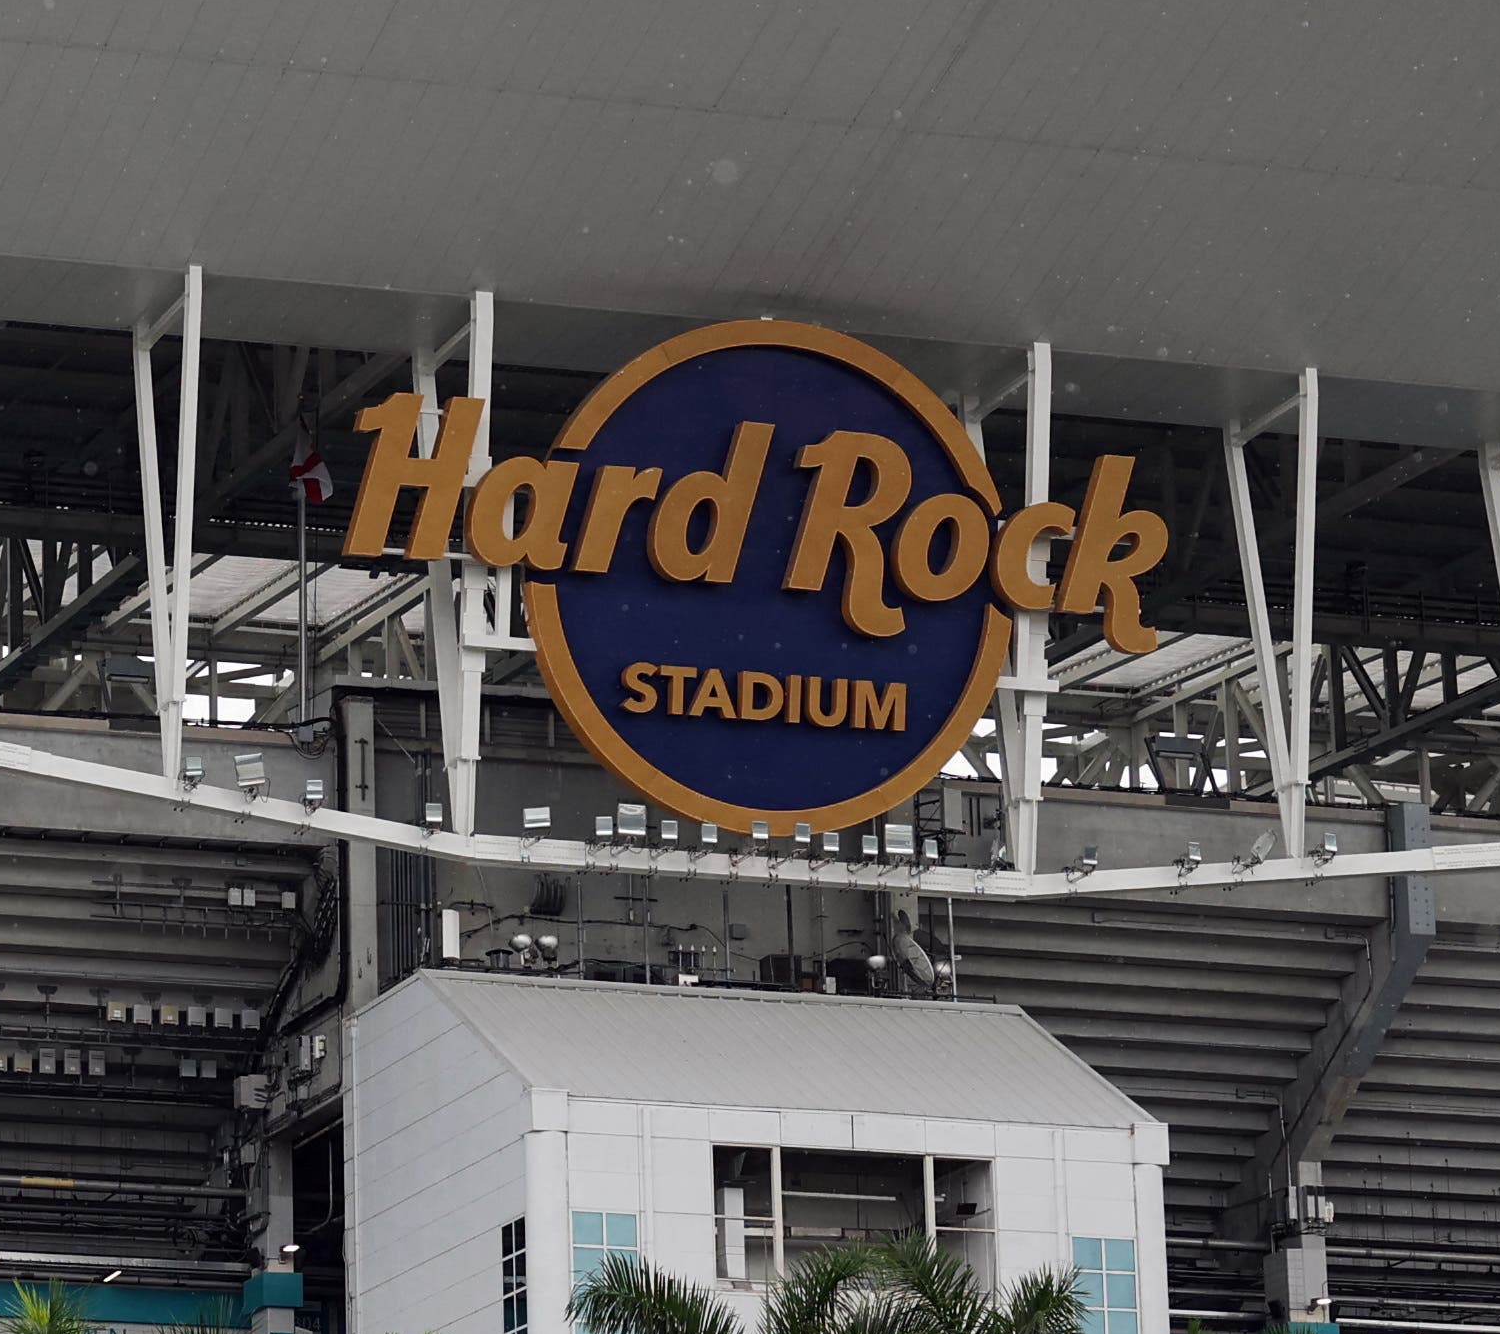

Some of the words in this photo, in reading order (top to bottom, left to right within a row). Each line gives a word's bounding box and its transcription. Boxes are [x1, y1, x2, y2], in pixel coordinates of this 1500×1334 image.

[342, 393, 776, 585] Hard
[782, 431, 1168, 655] Rock
[620, 661, 907, 732] STADIUM
